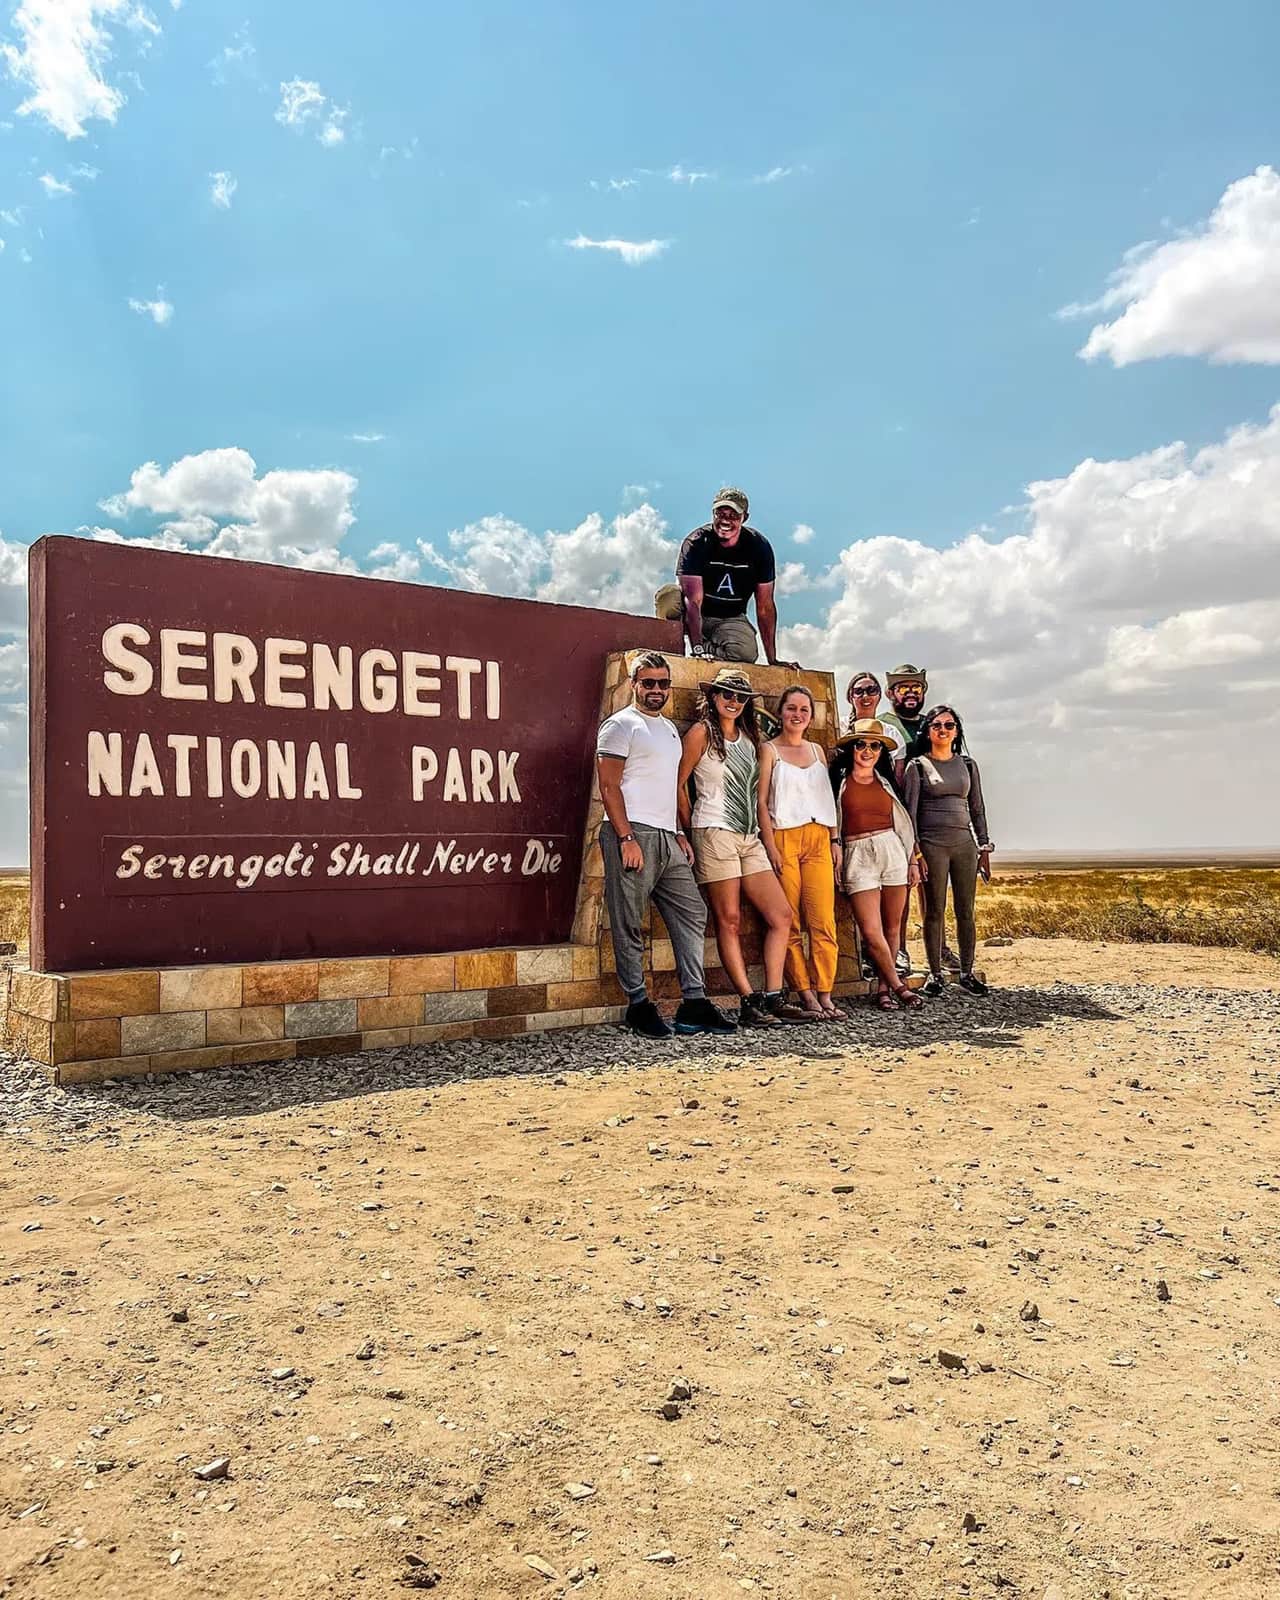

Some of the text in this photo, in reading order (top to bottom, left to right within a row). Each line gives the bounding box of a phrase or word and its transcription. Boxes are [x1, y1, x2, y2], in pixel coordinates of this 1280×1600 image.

[716, 573, 735, 596] A
[101, 622, 501, 720] SERENGETI
[87, 730, 522, 803] NATIONAL PARK
[115, 838, 563, 889] Serengeti Shall Never Die
